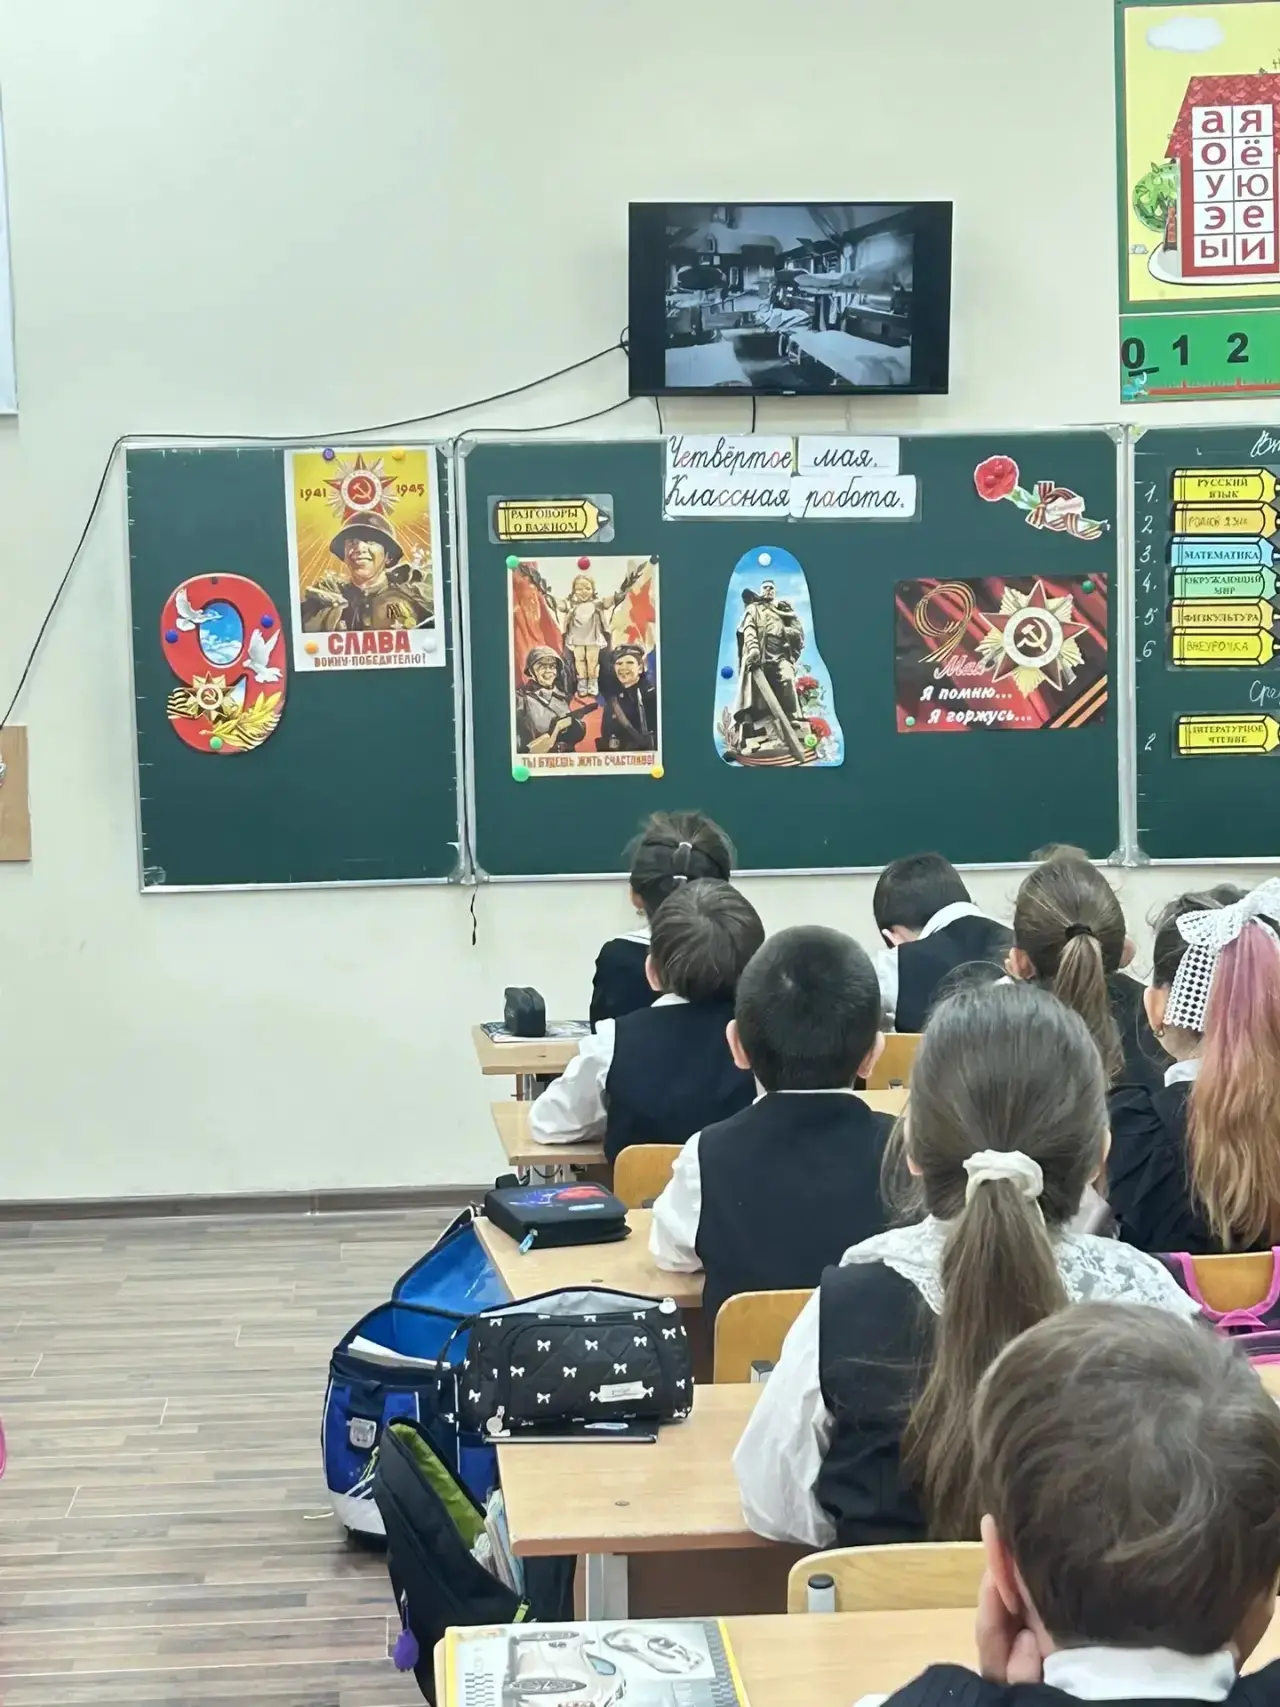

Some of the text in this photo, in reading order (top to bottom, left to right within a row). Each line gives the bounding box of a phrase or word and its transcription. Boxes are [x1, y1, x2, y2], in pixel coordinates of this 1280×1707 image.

[1201, 109, 1262, 133] а я
[1201, 139, 1263, 166] о ё
[1205, 174, 1269, 198] у ю
[1204, 204, 1265, 230] э е
[1201, 238, 1265, 261] ы и
[1121, 332, 1249, 369] 0 1 2
[668, 435, 878, 476] Четвёртое мая.
[1197, 477, 1248, 487] РУССКИЙ
[300, 484, 425, 501] 1941 1945
[664, 474, 905, 518] Классная работа.
[1208, 490, 1240, 498] ЯЗЫК
[511, 509, 578, 519] РАЗГОВОРЫ
[514, 522, 578, 532] О ВАЖНОМ
[1141, 515, 1153, 534] 2
[1184, 550, 1260, 560] МАТЕМАТИКА
[1186, 575, 1261, 584] ОКРУЖАЮЩИЙ
[1183, 613, 1259, 622] ФИЗКУЛЬТУРА
[327, 630, 412, 655] СЛАВА
[1142, 640, 1156, 657] 6
[314, 653, 426, 668] ВОИНУ-ПОБЕДИТЕЛЮ!
[920, 684, 1013, 701] Я помню...
[1249, 679, 1280, 707] Сре
[928, 708, 1032, 726] Я горжусь...
[521, 757, 536, 768] ТЫ
